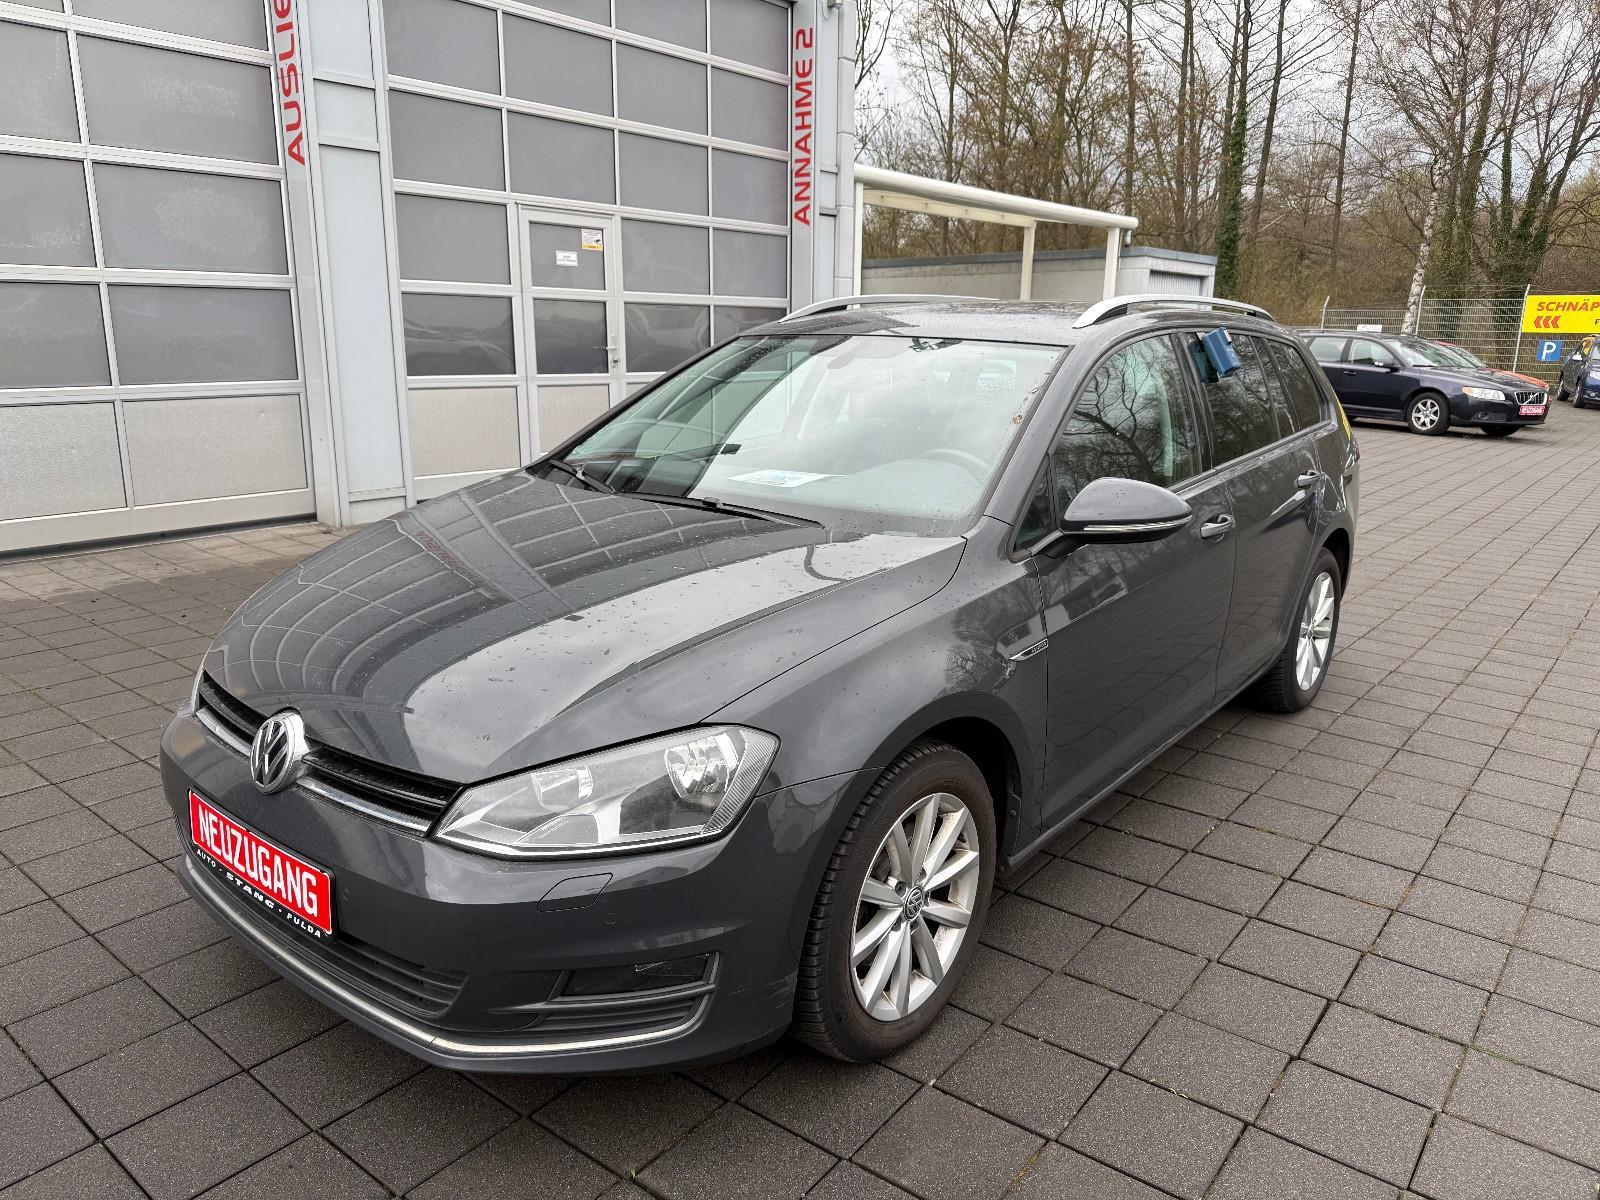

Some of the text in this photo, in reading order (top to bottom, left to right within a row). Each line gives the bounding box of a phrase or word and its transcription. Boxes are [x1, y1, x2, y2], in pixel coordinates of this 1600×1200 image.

[273, 0, 305, 165] AUSLIE
[794, 27, 814, 225] ANNAHME 2
[1536, 299, 1600, 311] SCHNÄP
[1542, 341, 1556, 361] P
[197, 849, 321, 938] AUTO STANG FULDA
[198, 803, 318, 918] NEUZUGANG
